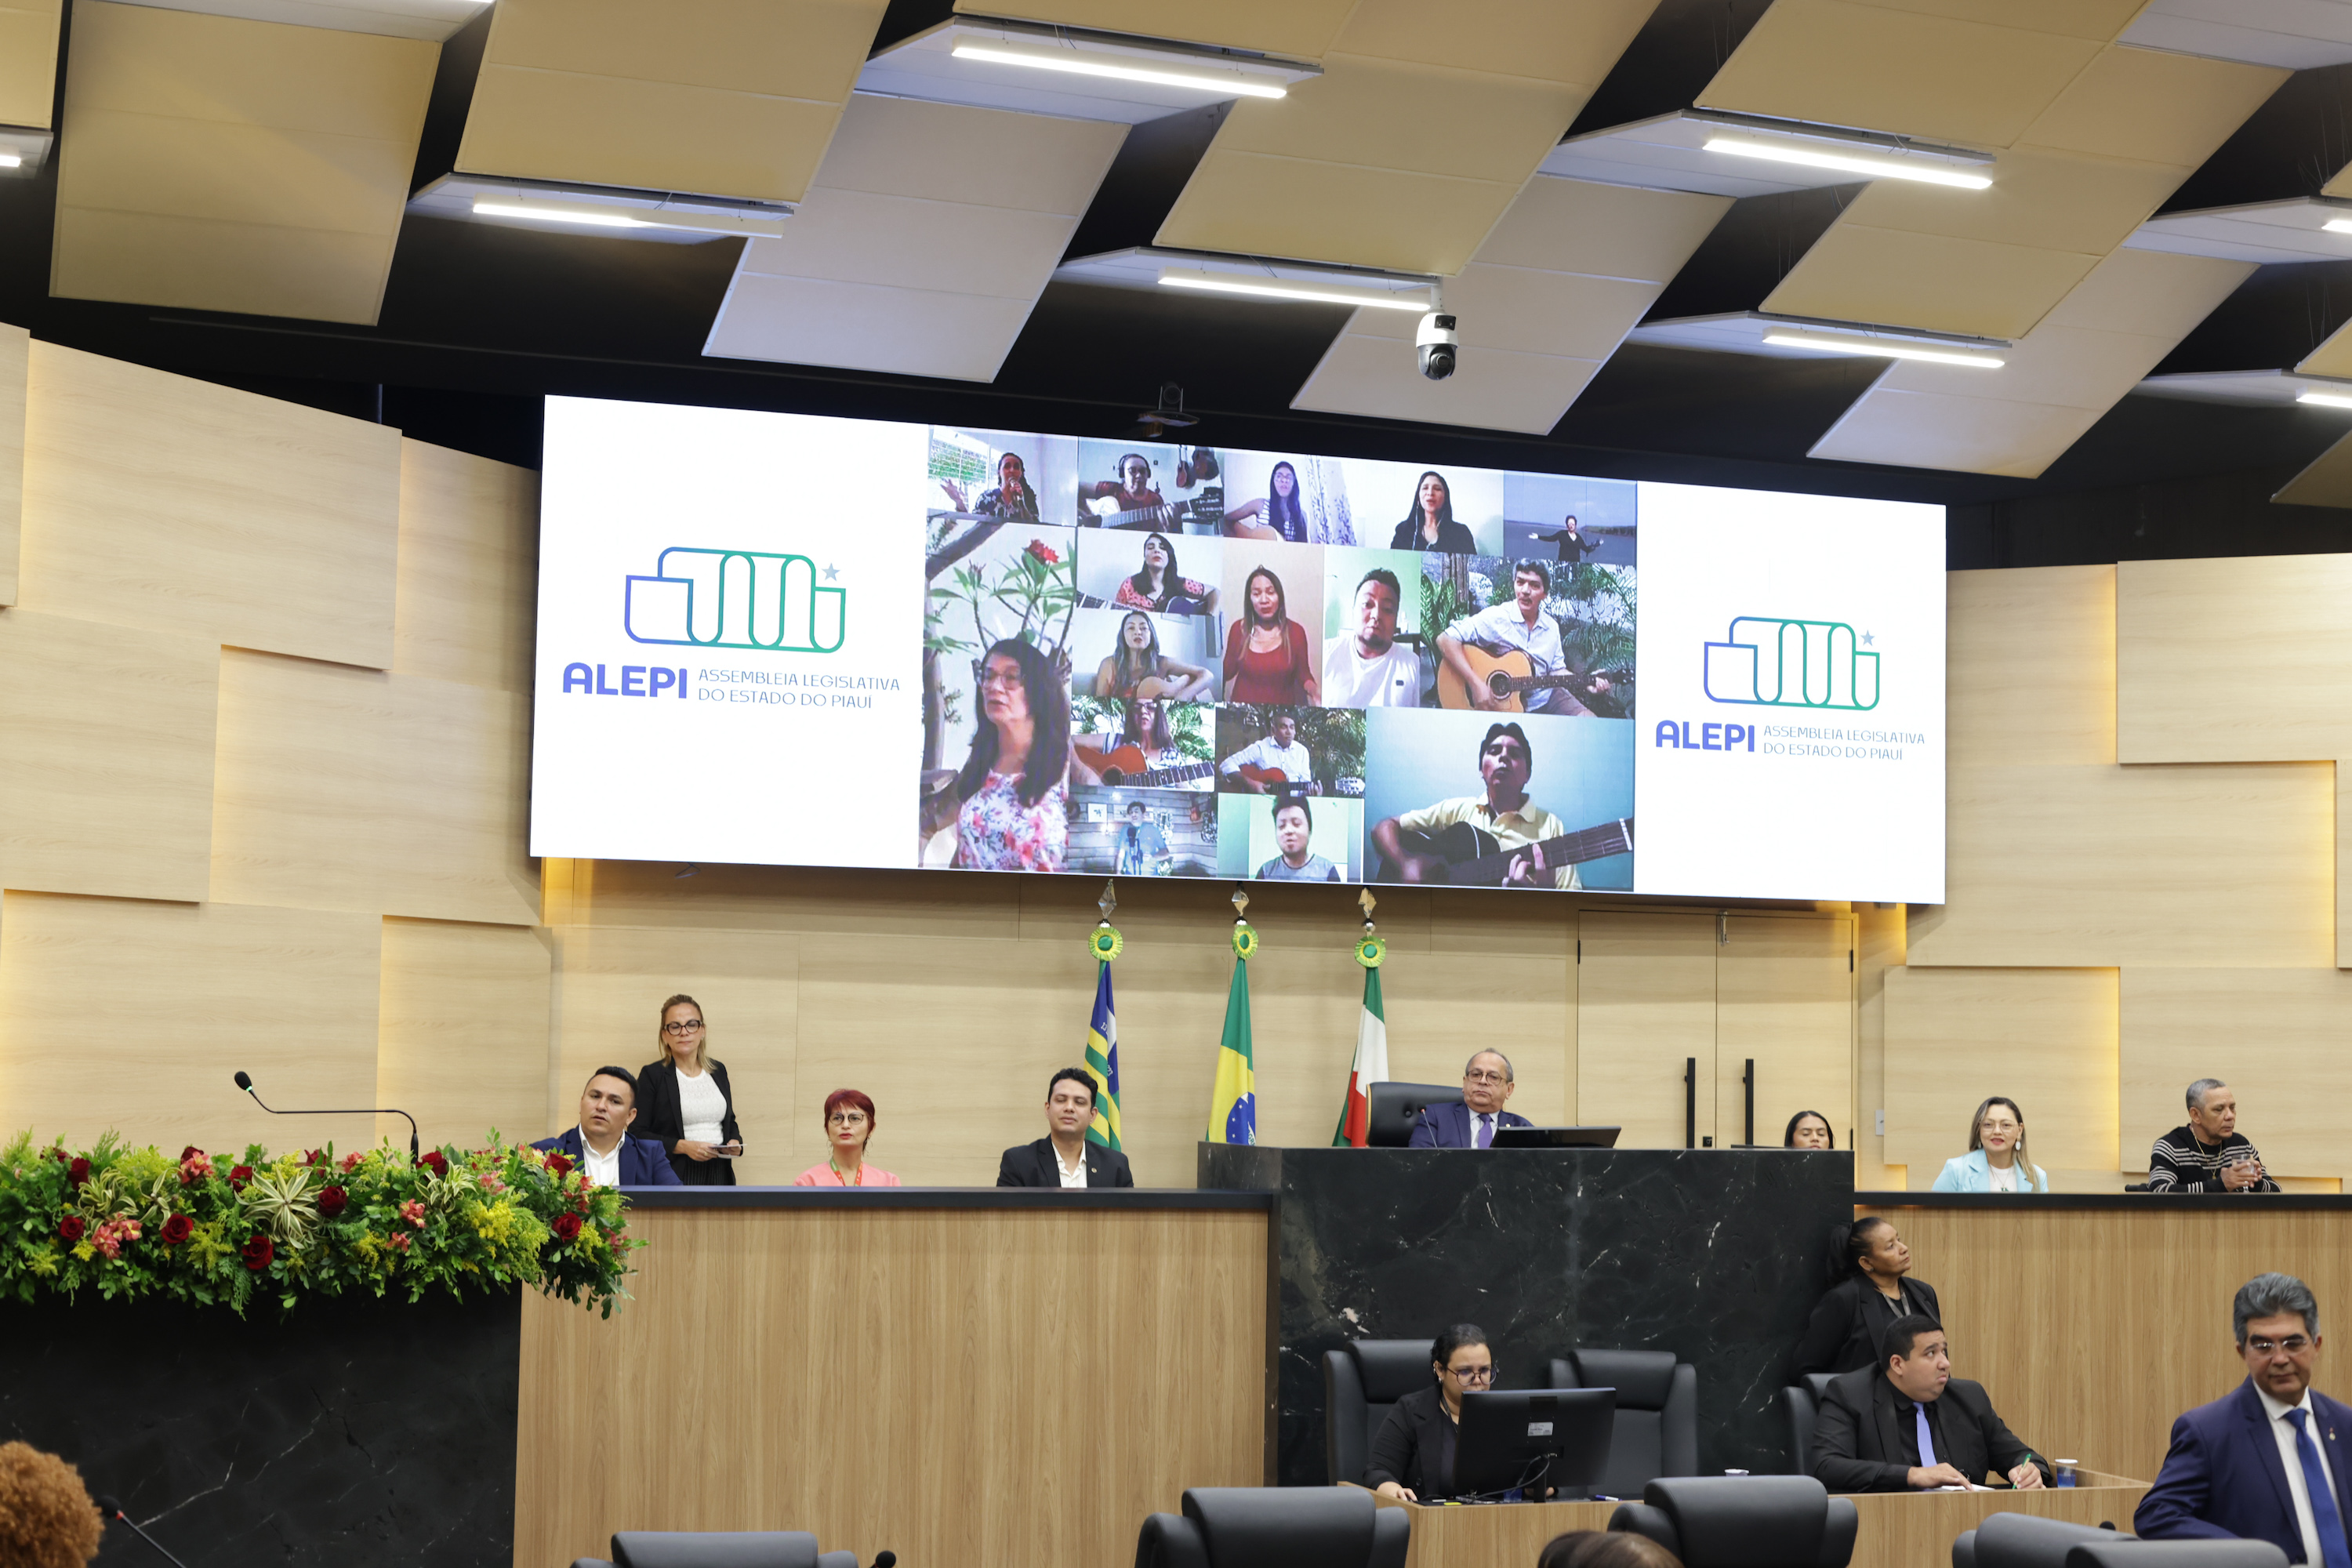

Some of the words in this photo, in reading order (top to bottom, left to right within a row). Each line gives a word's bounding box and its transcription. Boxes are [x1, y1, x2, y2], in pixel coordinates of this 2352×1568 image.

[562, 662, 688, 699] ALEPI
[699, 669, 798, 686] ASSEMBLEIA
[803, 673, 900, 691] LEGISLATIVA
[699, 688, 725, 702] DO
[730, 689, 797, 705] ESTADO
[800, 693, 827, 706] DO
[1655, 719, 1755, 753] ALEPI
[1763, 724, 1843, 740] ASSEMBLEIA
[1847, 729, 1925, 745] LEGISLATIVA
[1763, 742, 1785, 755] DO
[1789, 743, 1842, 757] ESTADO
[1846, 746, 1867, 759] DO
